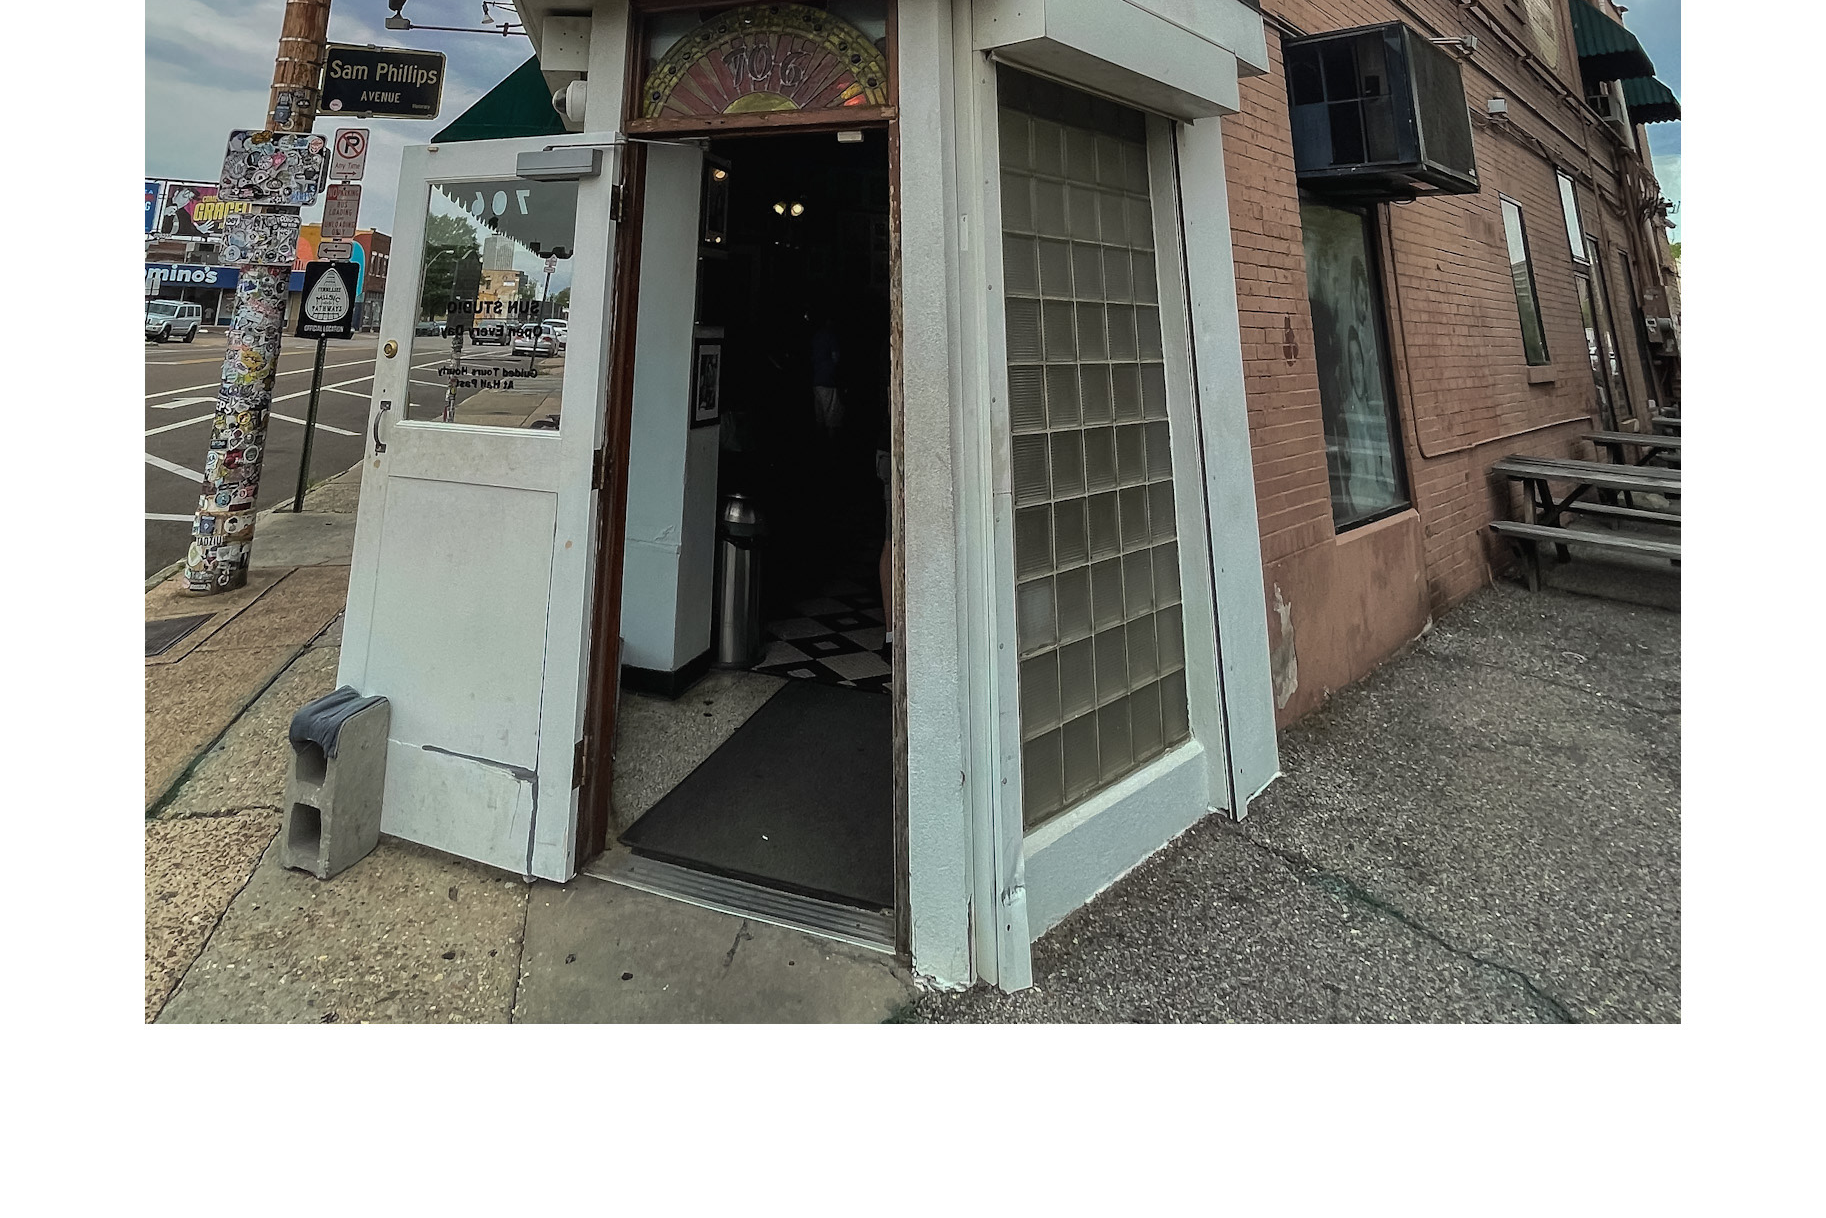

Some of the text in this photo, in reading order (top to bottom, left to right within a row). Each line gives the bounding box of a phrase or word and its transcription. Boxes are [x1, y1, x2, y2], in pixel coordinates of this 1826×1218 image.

[721, 43, 812, 87] 706
[330, 60, 438, 88] Sam Phillips
[360, 91, 401, 103] AVENUE
[335, 162, 360, 170] Any Time
[328, 188, 338, 198] NO
[329, 209, 353, 217] LOADING
[145, 264, 218, 283] mino's
[303, 324, 344, 332] OFFICIAL LOCATION
